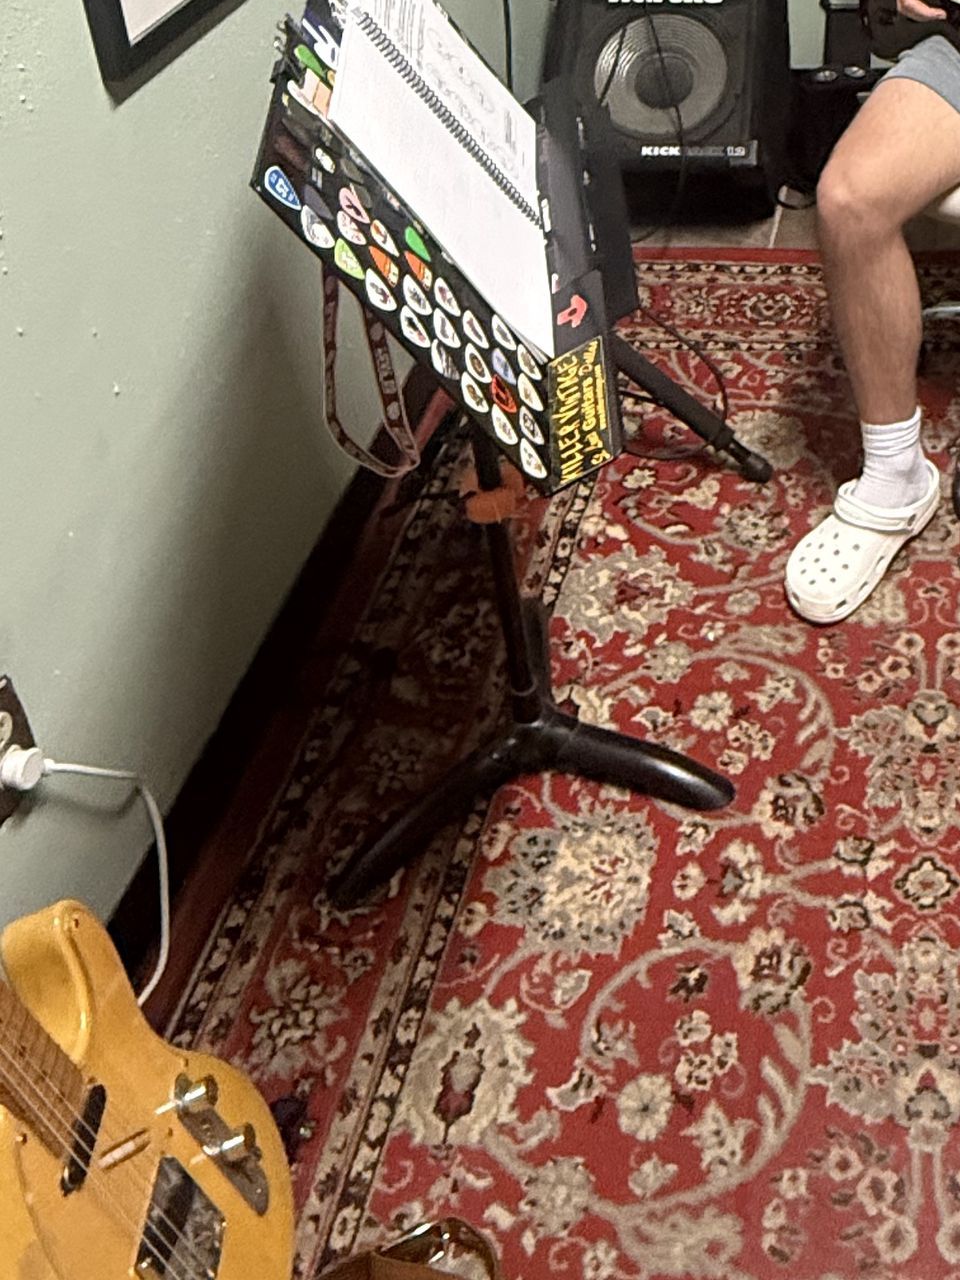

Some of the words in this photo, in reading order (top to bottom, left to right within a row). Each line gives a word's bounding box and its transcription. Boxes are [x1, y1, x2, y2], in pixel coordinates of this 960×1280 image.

[551, 353, 582, 424] VINTAGE
[581, 376, 597, 431] Guitars
[557, 419, 585, 486] KILLER
